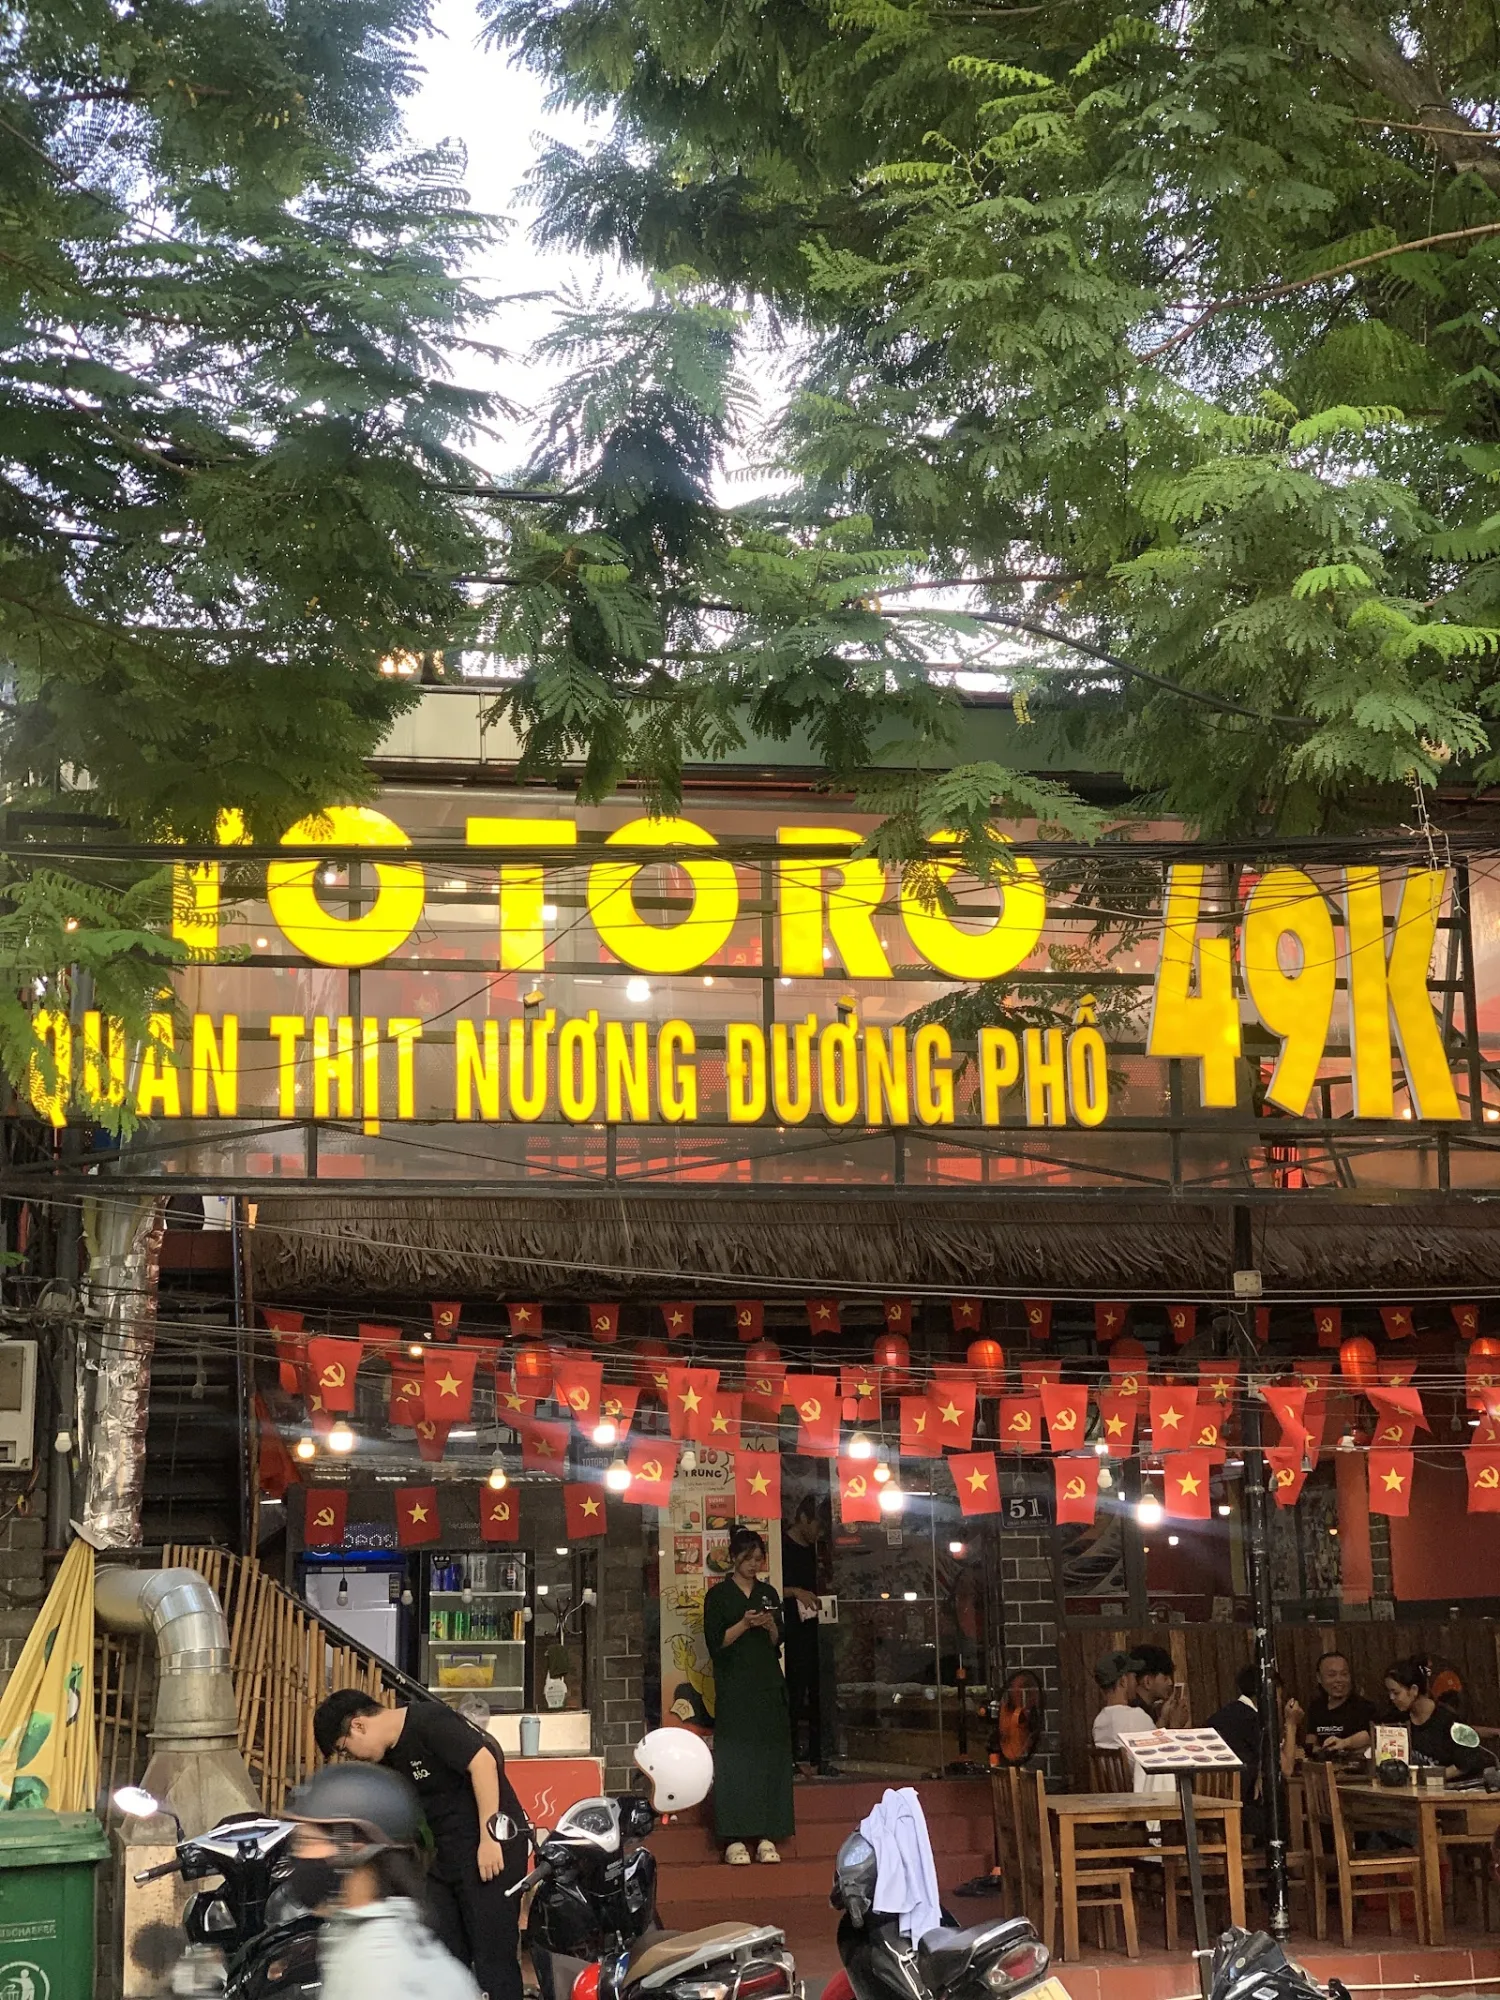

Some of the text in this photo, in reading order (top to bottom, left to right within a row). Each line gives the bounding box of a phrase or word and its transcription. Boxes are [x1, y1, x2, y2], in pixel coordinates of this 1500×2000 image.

[269, 1016, 423, 1136] THỊT
[456, 990, 697, 1123] NƯỚNG
[725, 994, 955, 1126] ĐƯỜNG
[979, 993, 1109, 1128] PHỐ
[1146, 864, 1462, 1121] 49K
[1009, 1497, 1043, 1519] 51
